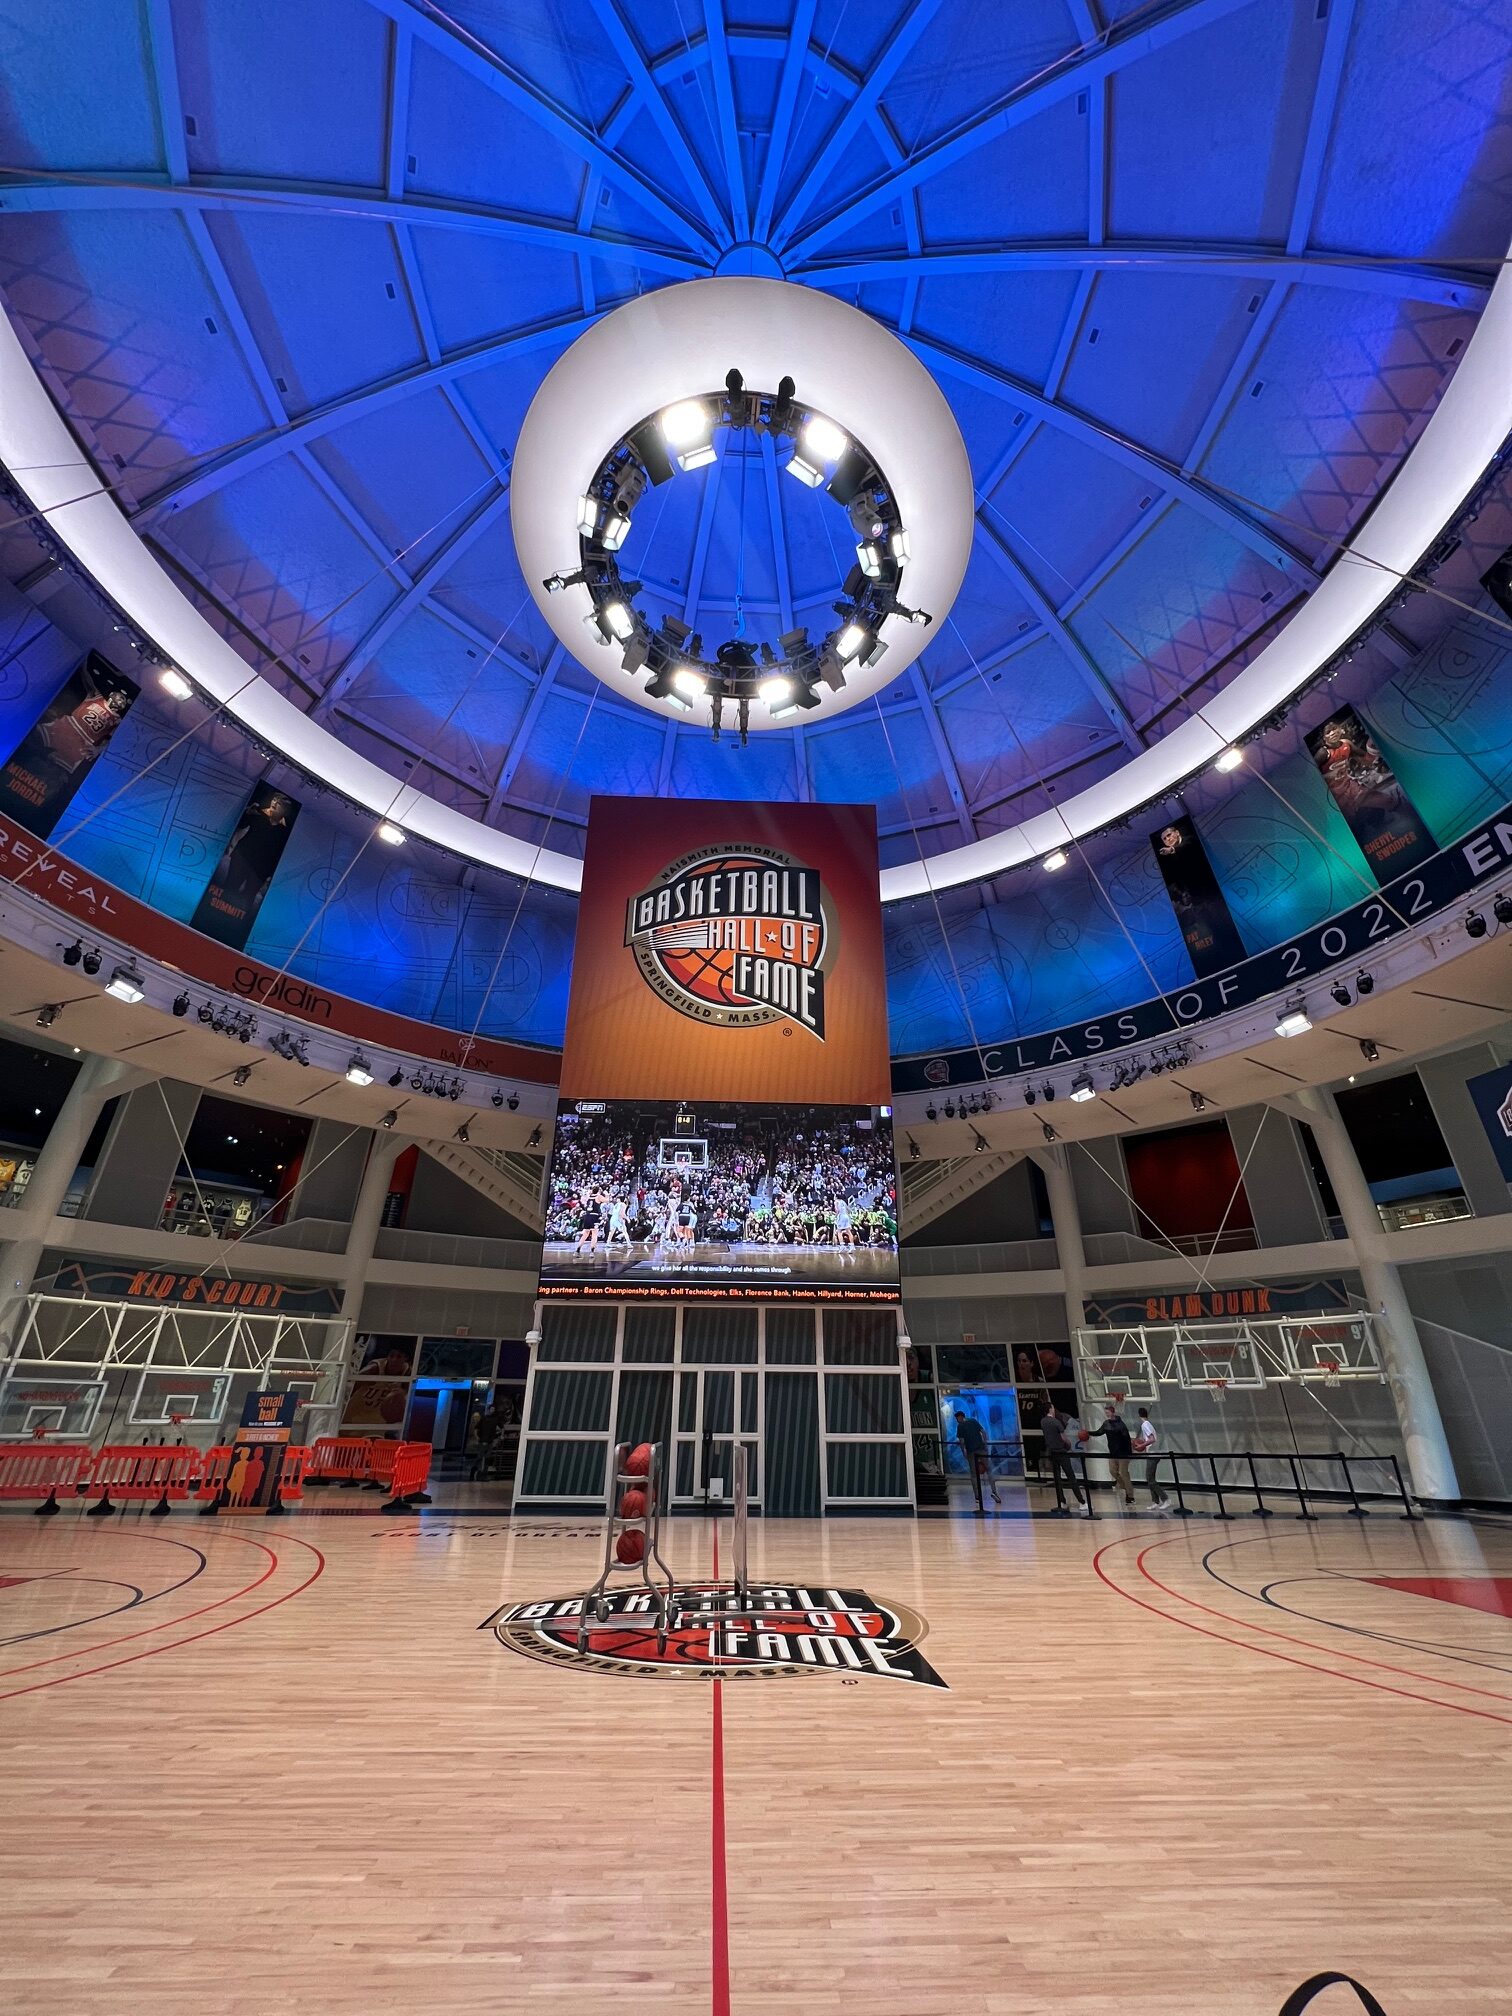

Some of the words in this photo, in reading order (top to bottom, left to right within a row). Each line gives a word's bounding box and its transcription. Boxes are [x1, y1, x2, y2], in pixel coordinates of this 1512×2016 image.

[82, 711, 104, 733] 23
[6, 778, 46, 806] JORDAN
[7, 762, 47, 794] MICHAEL
[1364, 831, 1396, 855] SHERYL
[1376, 832, 1418, 861] SWOOPES
[0, 828, 117, 915] REVEAL
[661, 847, 719, 880] NAISMITH
[724, 845, 790, 865] MEMORIAL
[209, 884, 224, 897] PAT
[639, 870, 814, 927] BASKETBALL
[210, 897, 246, 920] SUMMITT
[708, 920, 766, 953] HALL
[781, 922, 815, 963] OF
[1186, 931, 1199, 944] PAT
[640, 953, 712, 1018] SPRINGFIELD
[728, 1010, 776, 1023] MASS.
[739, 956, 816, 1026] FAME
[982, 1015, 1138, 1073] CLASS
[1176, 974, 1239, 1019] OF
[1281, 880, 1433, 978] 2022
[232, 966, 333, 1018] goldin
[581, 1104, 605, 1112] ESPN
[698, 1265, 732, 1274] responsibility
[771, 1266, 792, 1275] through
[127, 1270, 202, 1300] KID'S
[206, 1280, 286, 1307] COURT
[551, 1286, 579, 1295] partners
[604, 1287, 649, 1297] Championship
[650, 1287, 669, 1297] Rings,
[685, 1288, 728, 1298] Technologies,
[745, 1289, 773, 1297] Florence
[773, 1289, 791, 1297] Bank,
[792, 1289, 816, 1298] Hanlon,
[817, 1290, 843, 1299] Hillyard,
[844, 1290, 869, 1299] Horner,
[869, 1290, 900, 1300] Mohegan
[1146, 1293, 1201, 1320] SLAM
[1212, 1287, 1271, 1314] DUNK
[257, 1407, 278, 1421] ball
[258, 1393, 285, 1408] small
[1021, 1400, 1034, 1410] 10
[661, 1611, 777, 1631] LL
[806, 1612, 875, 1635] OF
[510, 1631, 659, 1674] SPRINGFIELD
[698, 1666, 816, 1677] MASS.
[726, 1632, 915, 1678] FAME
